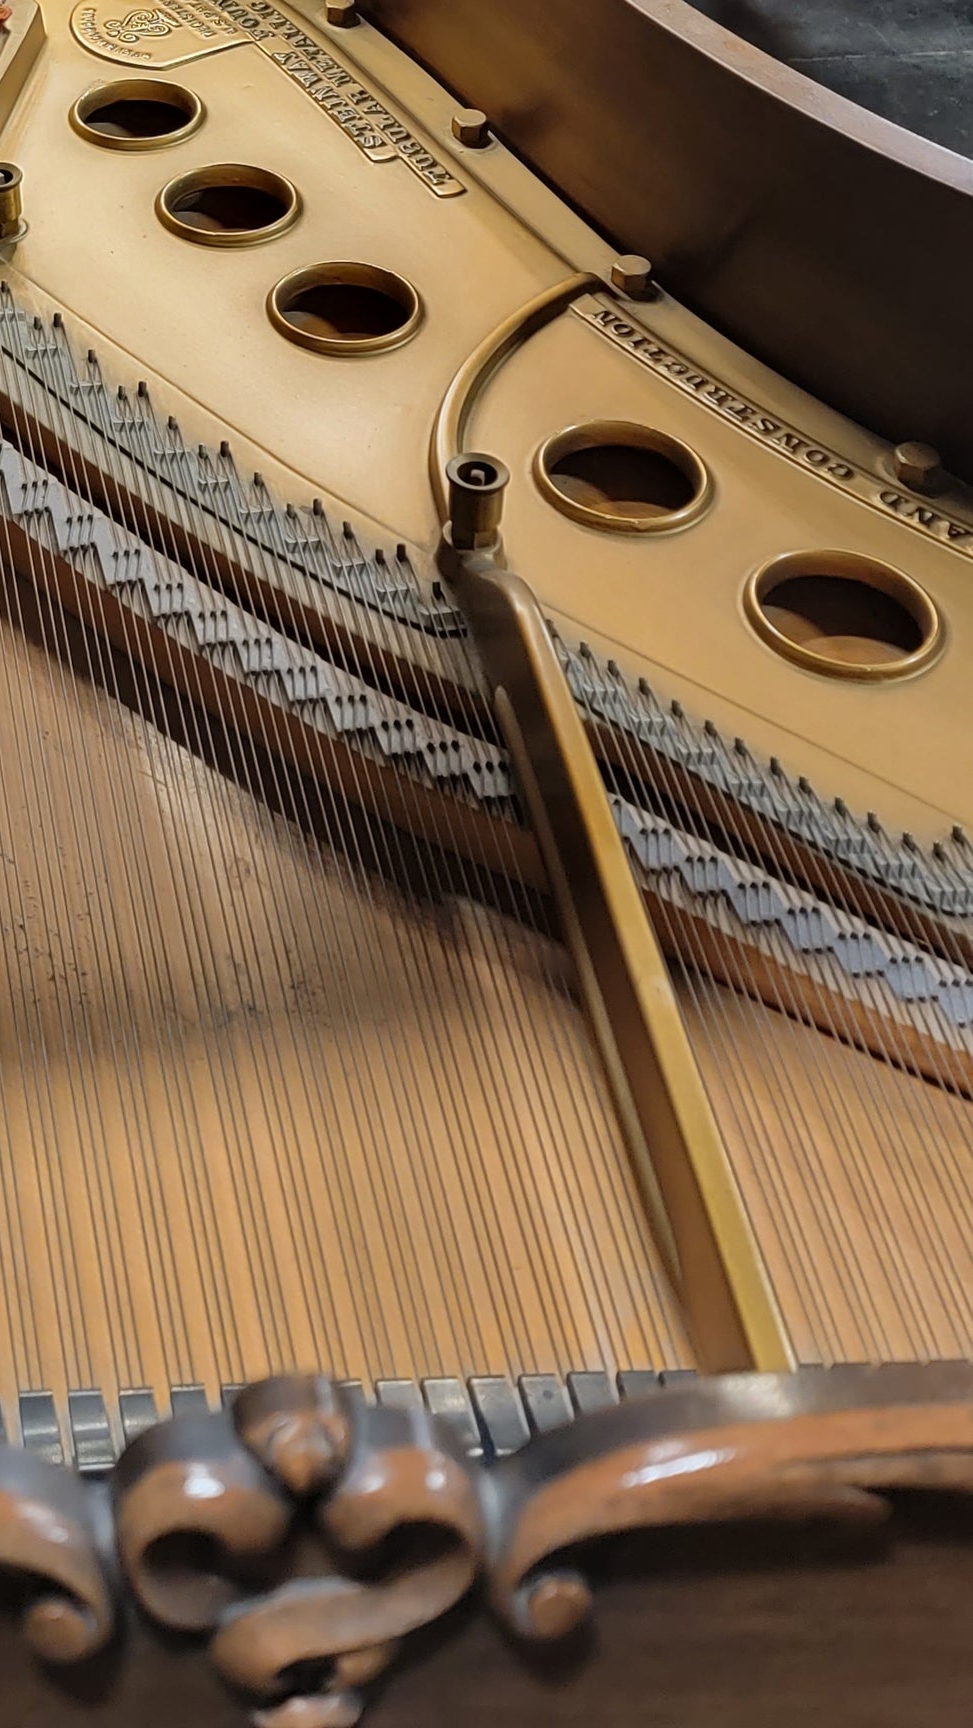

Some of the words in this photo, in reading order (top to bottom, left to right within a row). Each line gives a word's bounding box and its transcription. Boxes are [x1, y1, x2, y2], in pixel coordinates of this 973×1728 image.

[249, 0, 356, 88] METALLIC
[272, 51, 388, 149] STEINWAY
[347, 89, 454, 185] TUBULAR
[592, 309, 854, 481] CONSTRUCTION
[879, 491, 973, 540] AND
